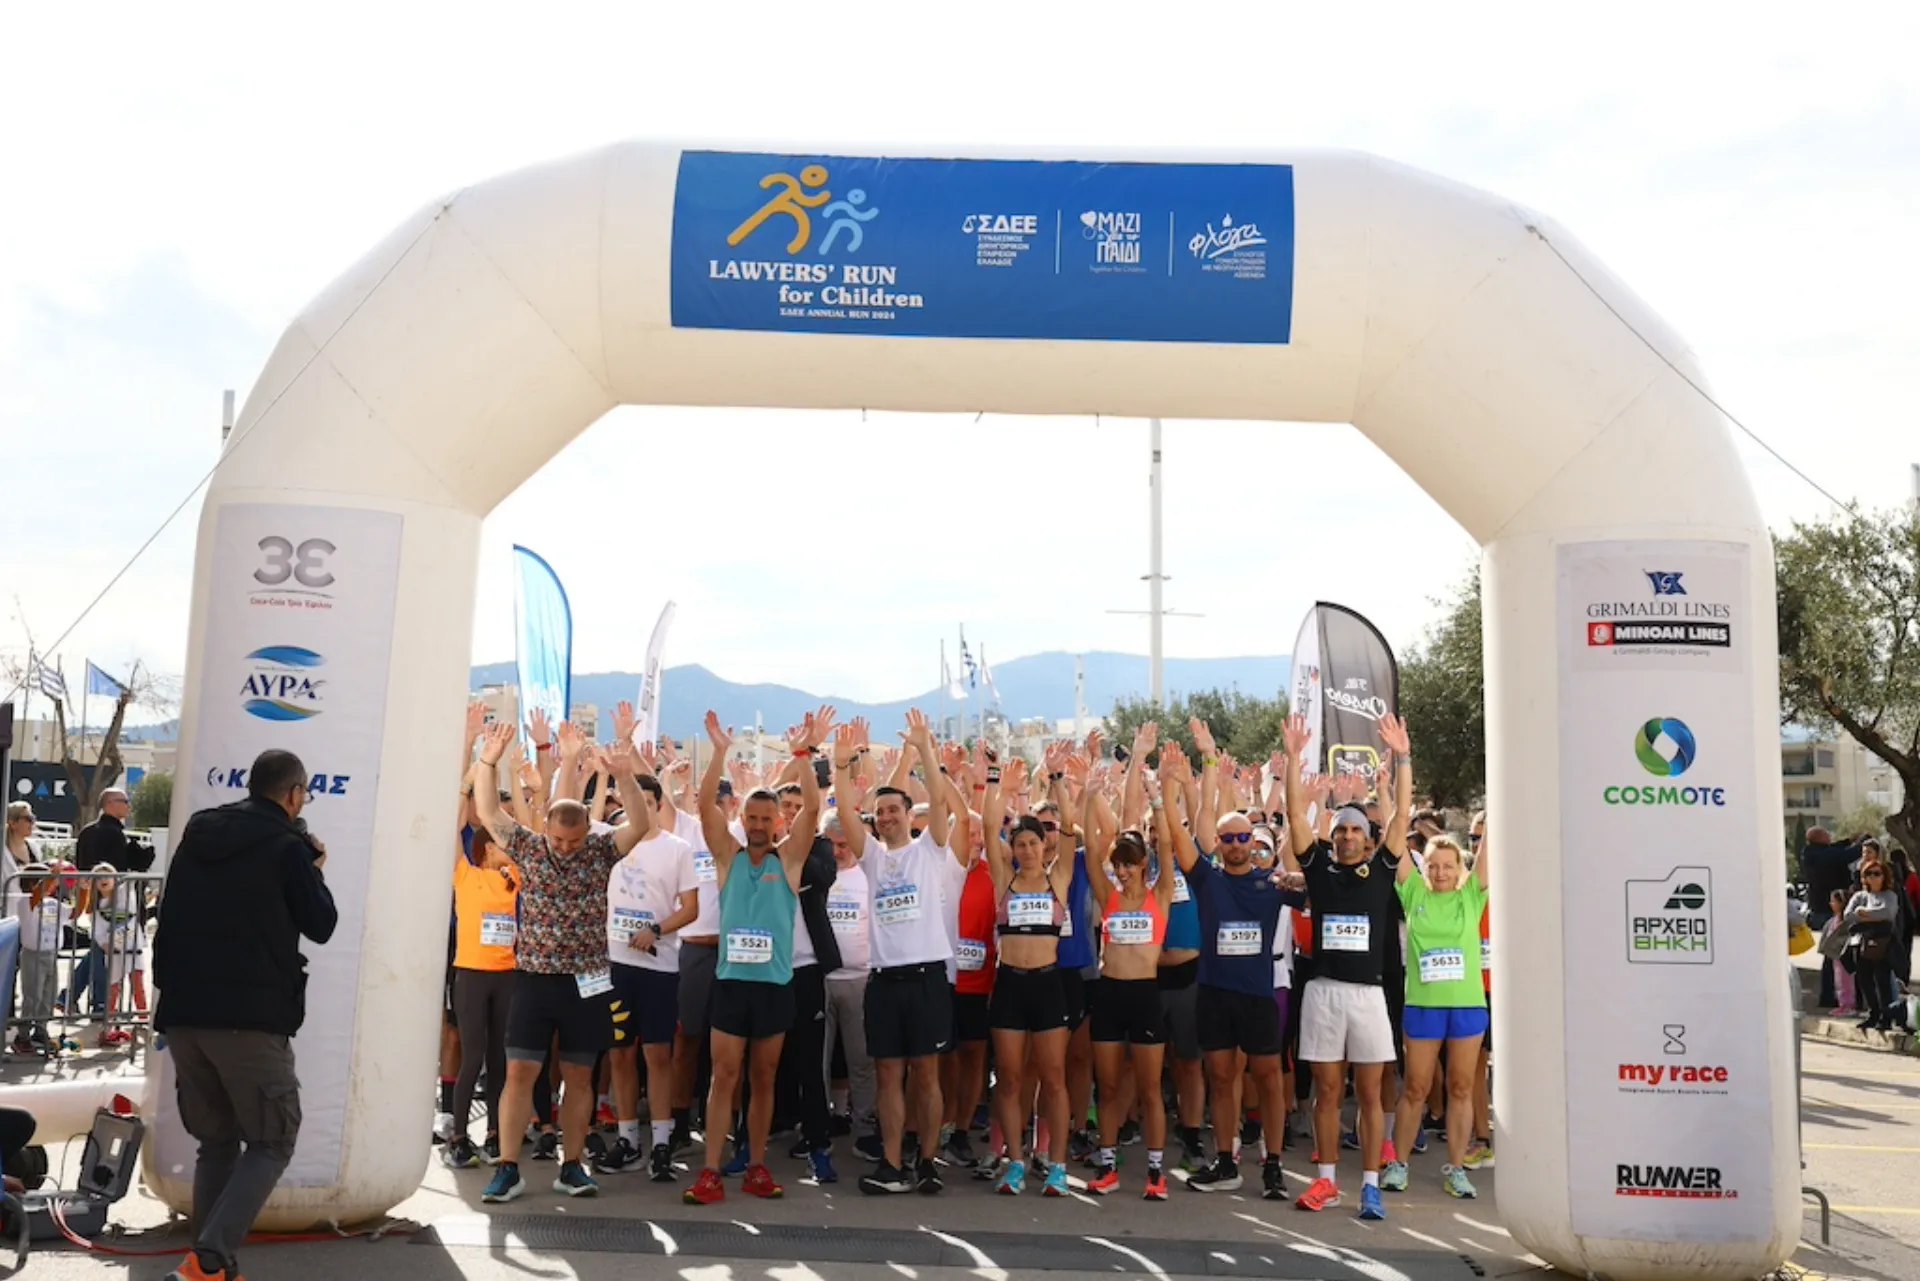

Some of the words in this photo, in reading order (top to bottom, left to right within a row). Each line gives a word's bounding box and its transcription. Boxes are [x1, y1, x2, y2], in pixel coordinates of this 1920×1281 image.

[978, 215, 1037, 233] ΣΔΕΕ
[1098, 212, 1141, 233] ΜΑΖΙ
[1097, 241, 1140, 263] ΠΑΙΔΙ
[843, 265, 897, 285] RUN
[779, 284, 814, 305] for
[821, 286, 924, 308] Children
[807, 308, 847, 318] ANNUAL
[848, 310, 870, 319] RUN
[1586, 602, 1678, 619] GRIMALDI
[1684, 602, 1731, 619] LINES
[1615, 626, 1685, 640] MINOAN
[1688, 627, 1728, 642] LINES
[1603, 786, 1726, 806] COSMOTE
[886, 894, 916, 909] 5041
[1021, 900, 1050, 911] 5146
[1336, 924, 1366, 937] 5475
[1633, 917, 1707, 935] ΑΡΧΕΙΟ
[740, 937, 769, 949] 5521
[1231, 930, 1258, 942] 5197
[1431, 956, 1461, 967] 5633
[1618, 1064, 1664, 1086] my
[1669, 1065, 1728, 1083] race
[1616, 1164, 1722, 1189] RUNNER
